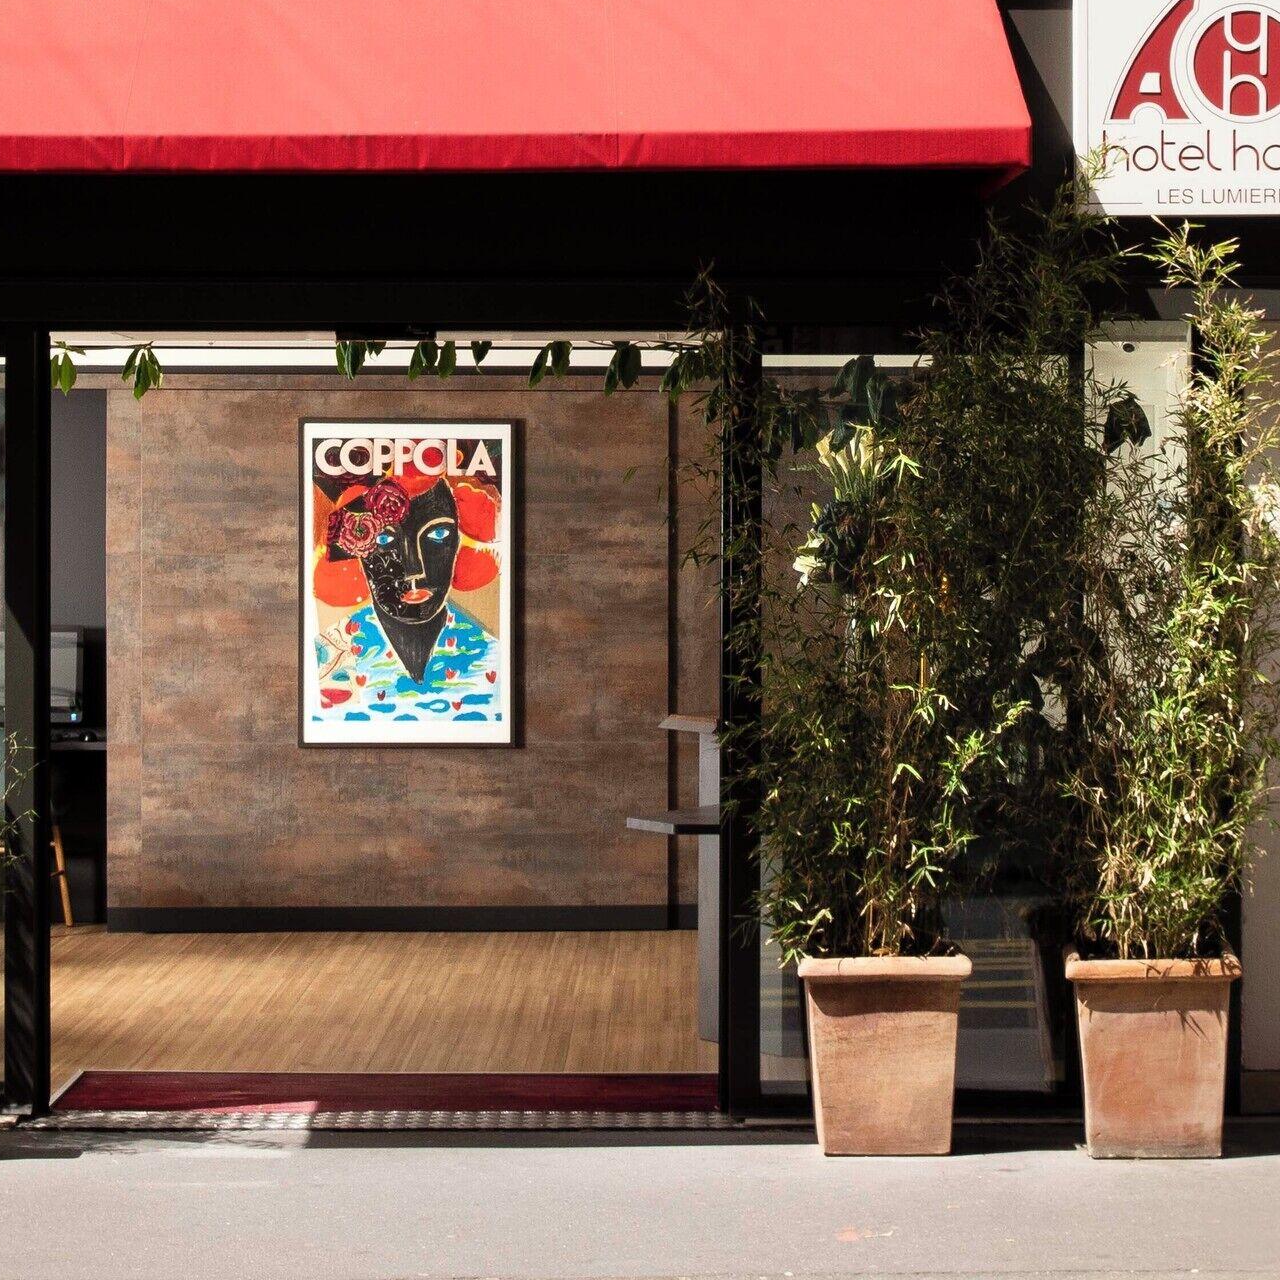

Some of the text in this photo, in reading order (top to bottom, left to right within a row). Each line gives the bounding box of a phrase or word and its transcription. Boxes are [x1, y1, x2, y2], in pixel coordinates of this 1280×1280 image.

[1100, 128, 1222, 172] hotel
[1156, 187, 1195, 205] LES
[314, 437, 497, 477] COPPOLA
